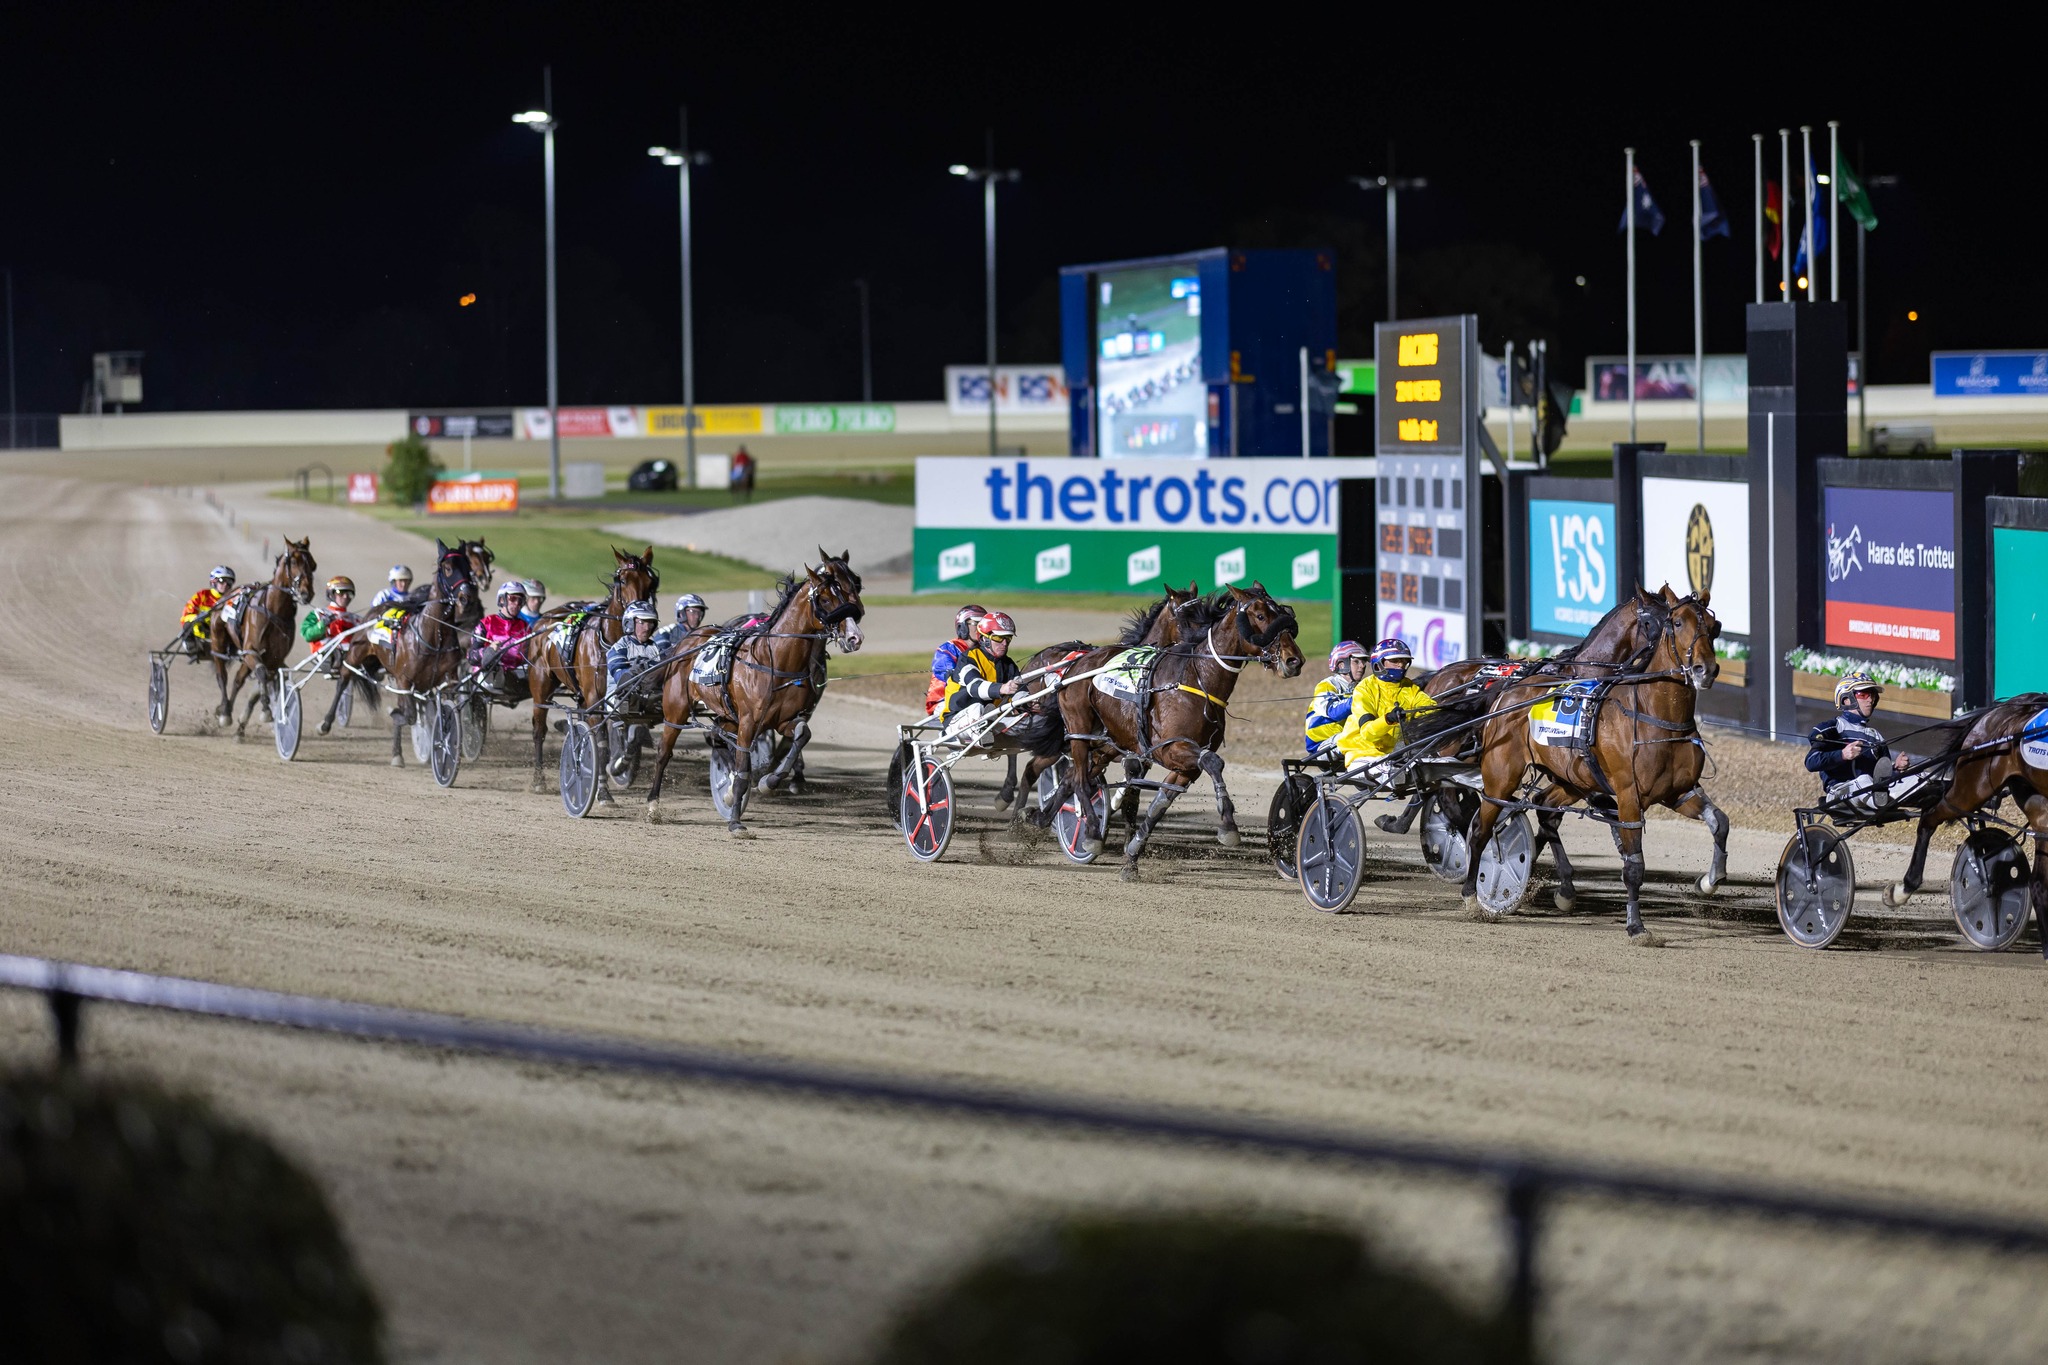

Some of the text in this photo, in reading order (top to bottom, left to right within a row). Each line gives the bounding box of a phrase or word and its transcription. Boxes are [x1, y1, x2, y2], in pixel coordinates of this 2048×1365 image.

[945, 554, 969, 569] TAB
[1549, 514, 1606, 605] VSS
[1867, 541, 1895, 566] Haras
[1897, 542, 1915, 567] des
[1042, 556, 1066, 571] TAB
[1133, 558, 1156, 573] TAB
[1220, 560, 1241, 575] TAB
[1297, 562, 1315, 577] TAB
[1849, 619, 1940, 642] BREEDING WORLD CLASS TROTTEURS
[2028, 746, 2046, 756] TROTS
